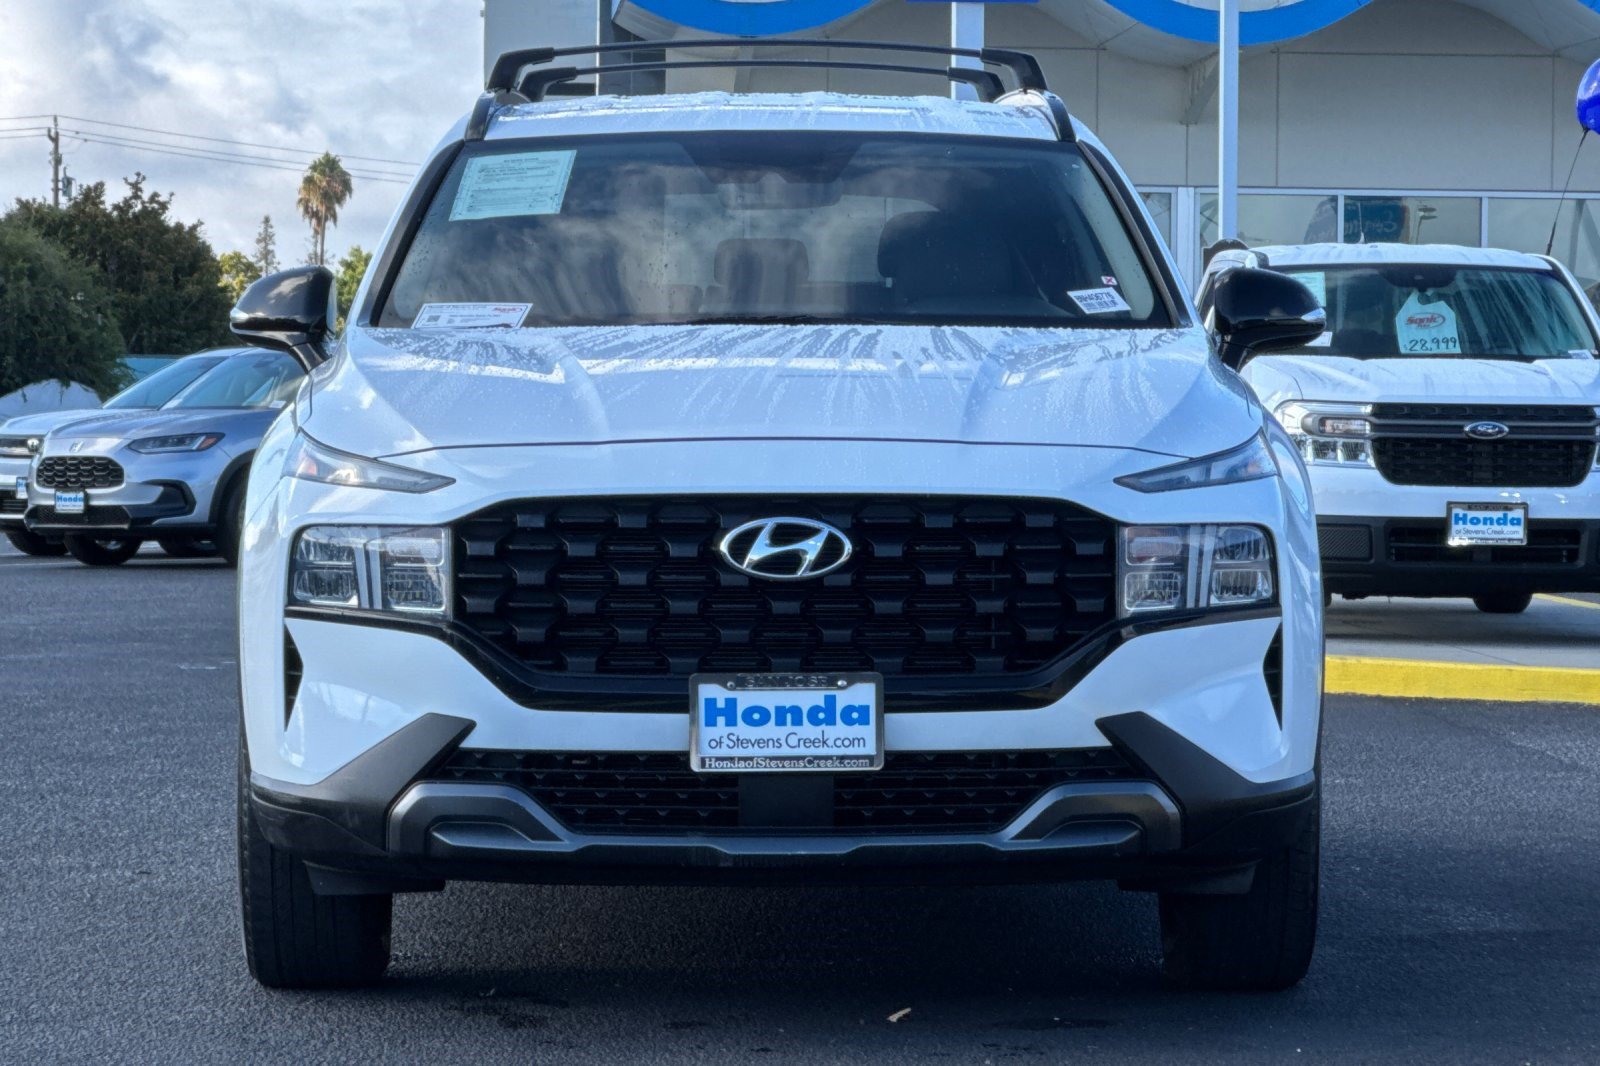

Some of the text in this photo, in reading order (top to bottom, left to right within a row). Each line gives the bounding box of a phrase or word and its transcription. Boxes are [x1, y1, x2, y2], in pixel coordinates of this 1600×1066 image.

[1454, 512, 1522, 526] Honda
[704, 694, 870, 727] Honda
[708, 730, 866, 749] of Stevens Creek.com
[704, 757, 870, 769] HondaofStevensCreek.com
